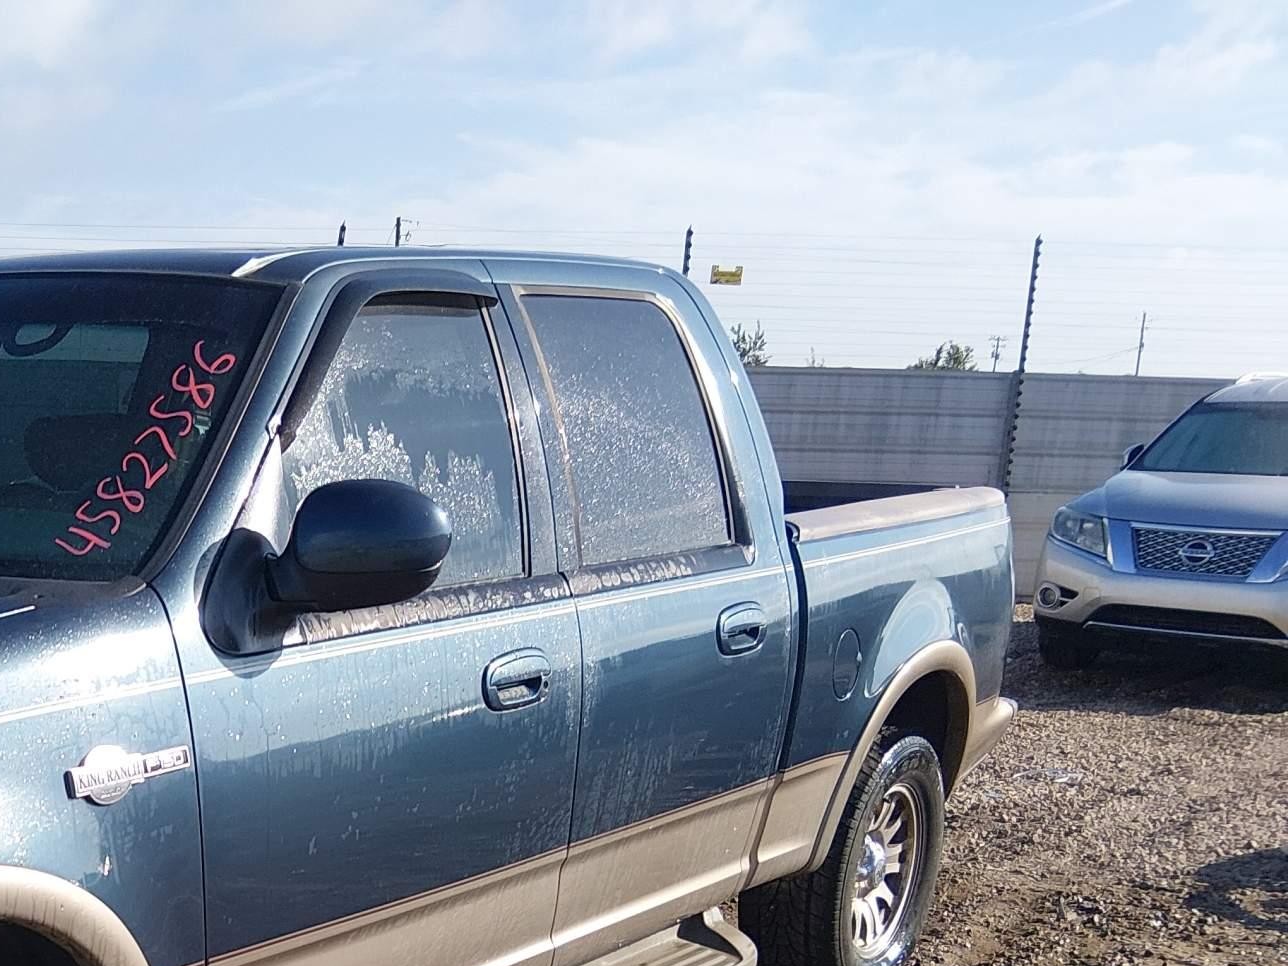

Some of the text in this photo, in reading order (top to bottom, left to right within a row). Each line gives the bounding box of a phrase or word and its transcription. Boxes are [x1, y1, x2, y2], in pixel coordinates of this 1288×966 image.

[55, 339, 236, 556] 45827586
[78, 760, 141, 790] KING RANCH
